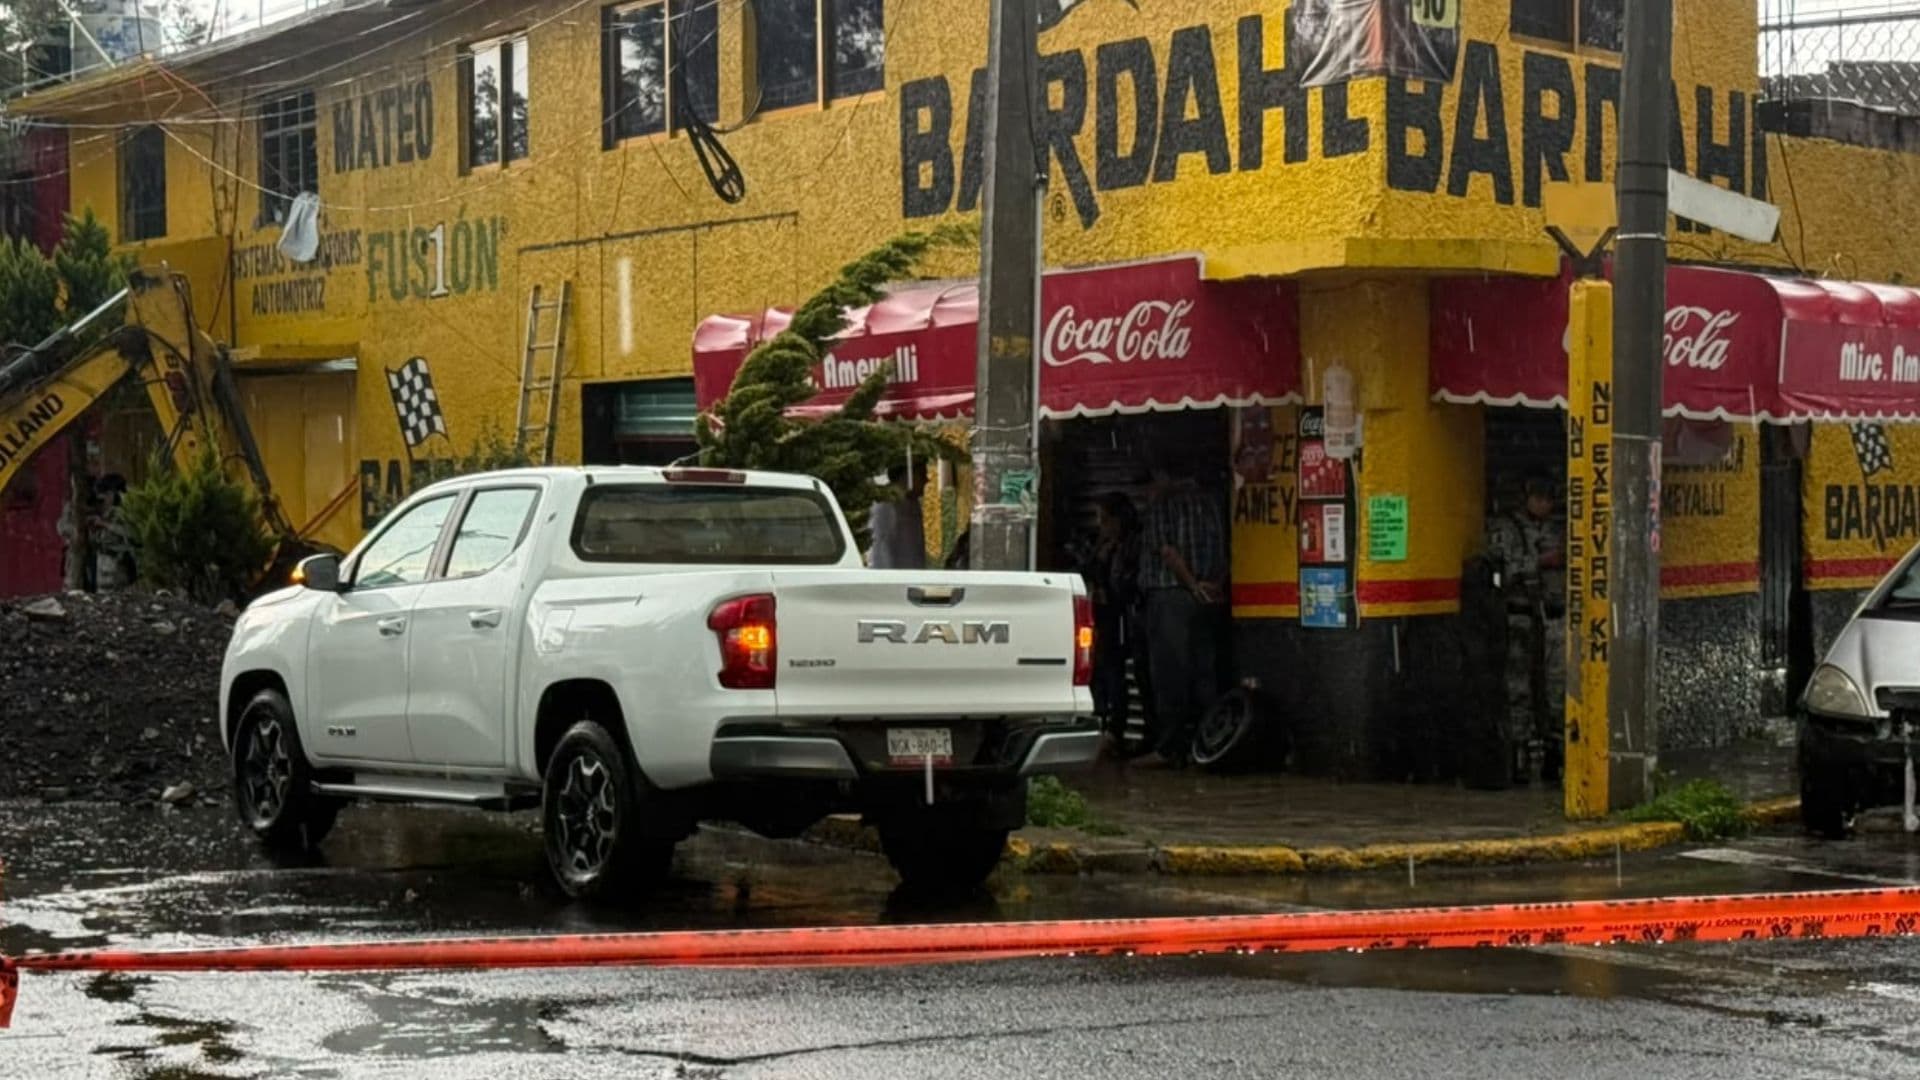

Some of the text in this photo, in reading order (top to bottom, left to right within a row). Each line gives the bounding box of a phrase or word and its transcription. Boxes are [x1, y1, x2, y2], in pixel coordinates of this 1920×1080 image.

[333, 81, 434, 174] MATEO
[252, 277, 326, 316] AUTOMOTRIZ
[1043, 299, 1195, 367] Coca-Cola
[1592, 381, 1610, 424] NO
[1570, 416, 1584, 458] NO
[857, 619, 1010, 644] RAM
[1590, 617, 1608, 662] KM
